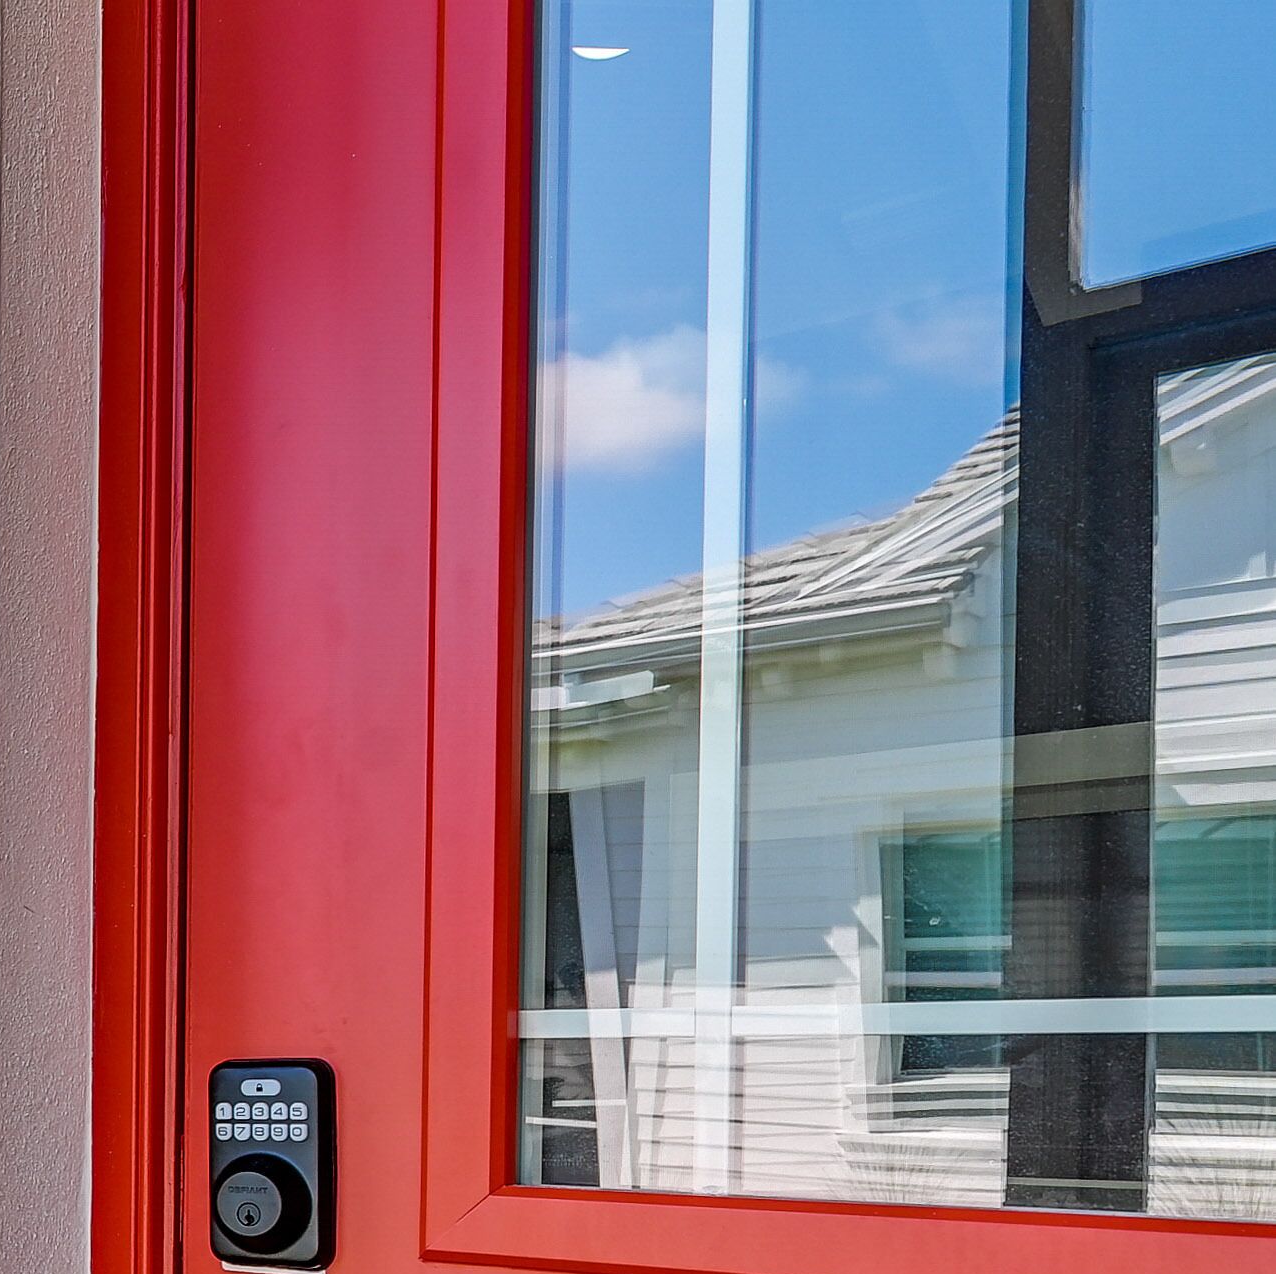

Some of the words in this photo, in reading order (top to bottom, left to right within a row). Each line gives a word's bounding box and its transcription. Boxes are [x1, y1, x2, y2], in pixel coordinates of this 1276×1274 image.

[235, 1107, 246, 1117] 2
[254, 1107, 265, 1117] 3
[273, 1107, 283, 1116] 4
[292, 1107, 303, 1117] 5
[218, 1126, 228, 1136] 6
[236, 1126, 246, 1136] 7
[254, 1126, 265, 1137] 8
[273, 1126, 283, 1137] 9
[292, 1126, 302, 1137] 0
